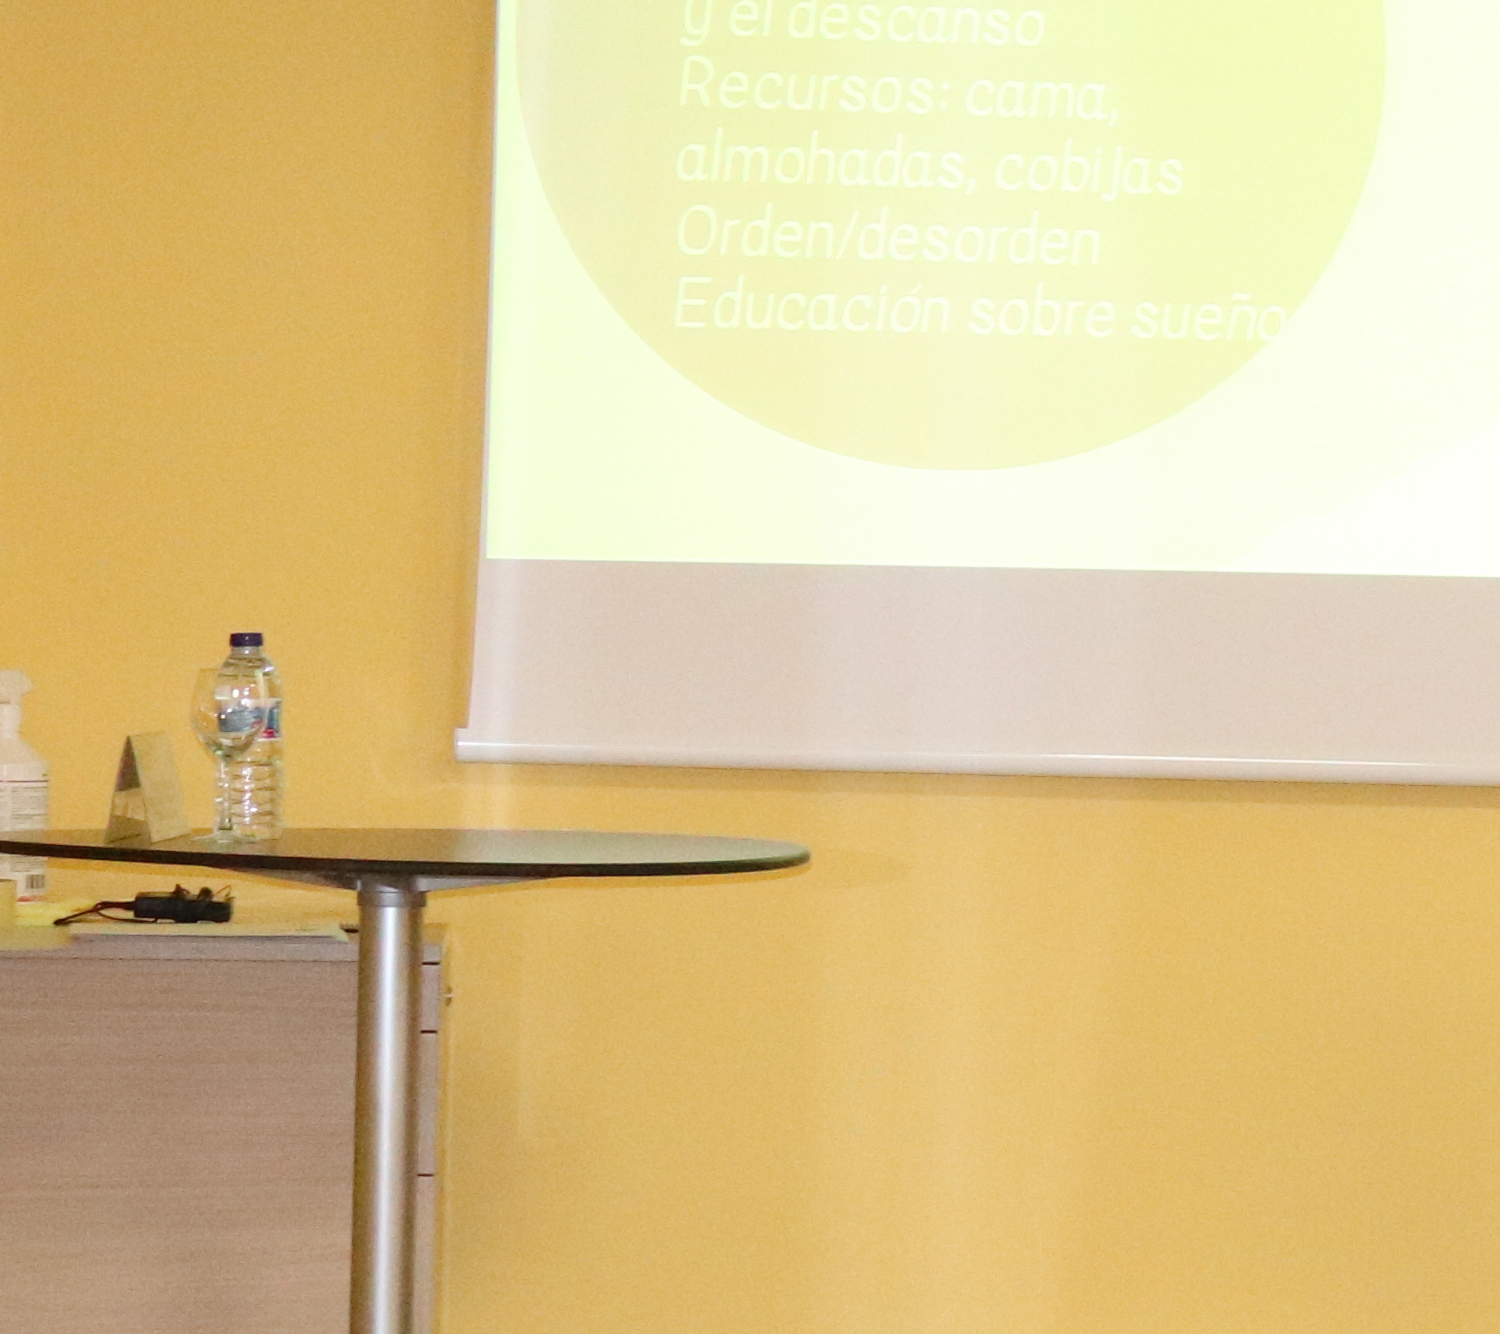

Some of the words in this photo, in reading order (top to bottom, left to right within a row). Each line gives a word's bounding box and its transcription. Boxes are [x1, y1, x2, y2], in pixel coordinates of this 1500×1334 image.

[679, 56, 952, 113] Recursos:
[966, 74, 1120, 123] cama,
[676, 129, 976, 194] almohadas,
[994, 144, 1184, 201] cobijas
[676, 204, 1101, 265] Orden/desorden
[675, 276, 949, 333] Educación
[968, 283, 1115, 337] sobre
[1132, 292, 1288, 341] sueño
